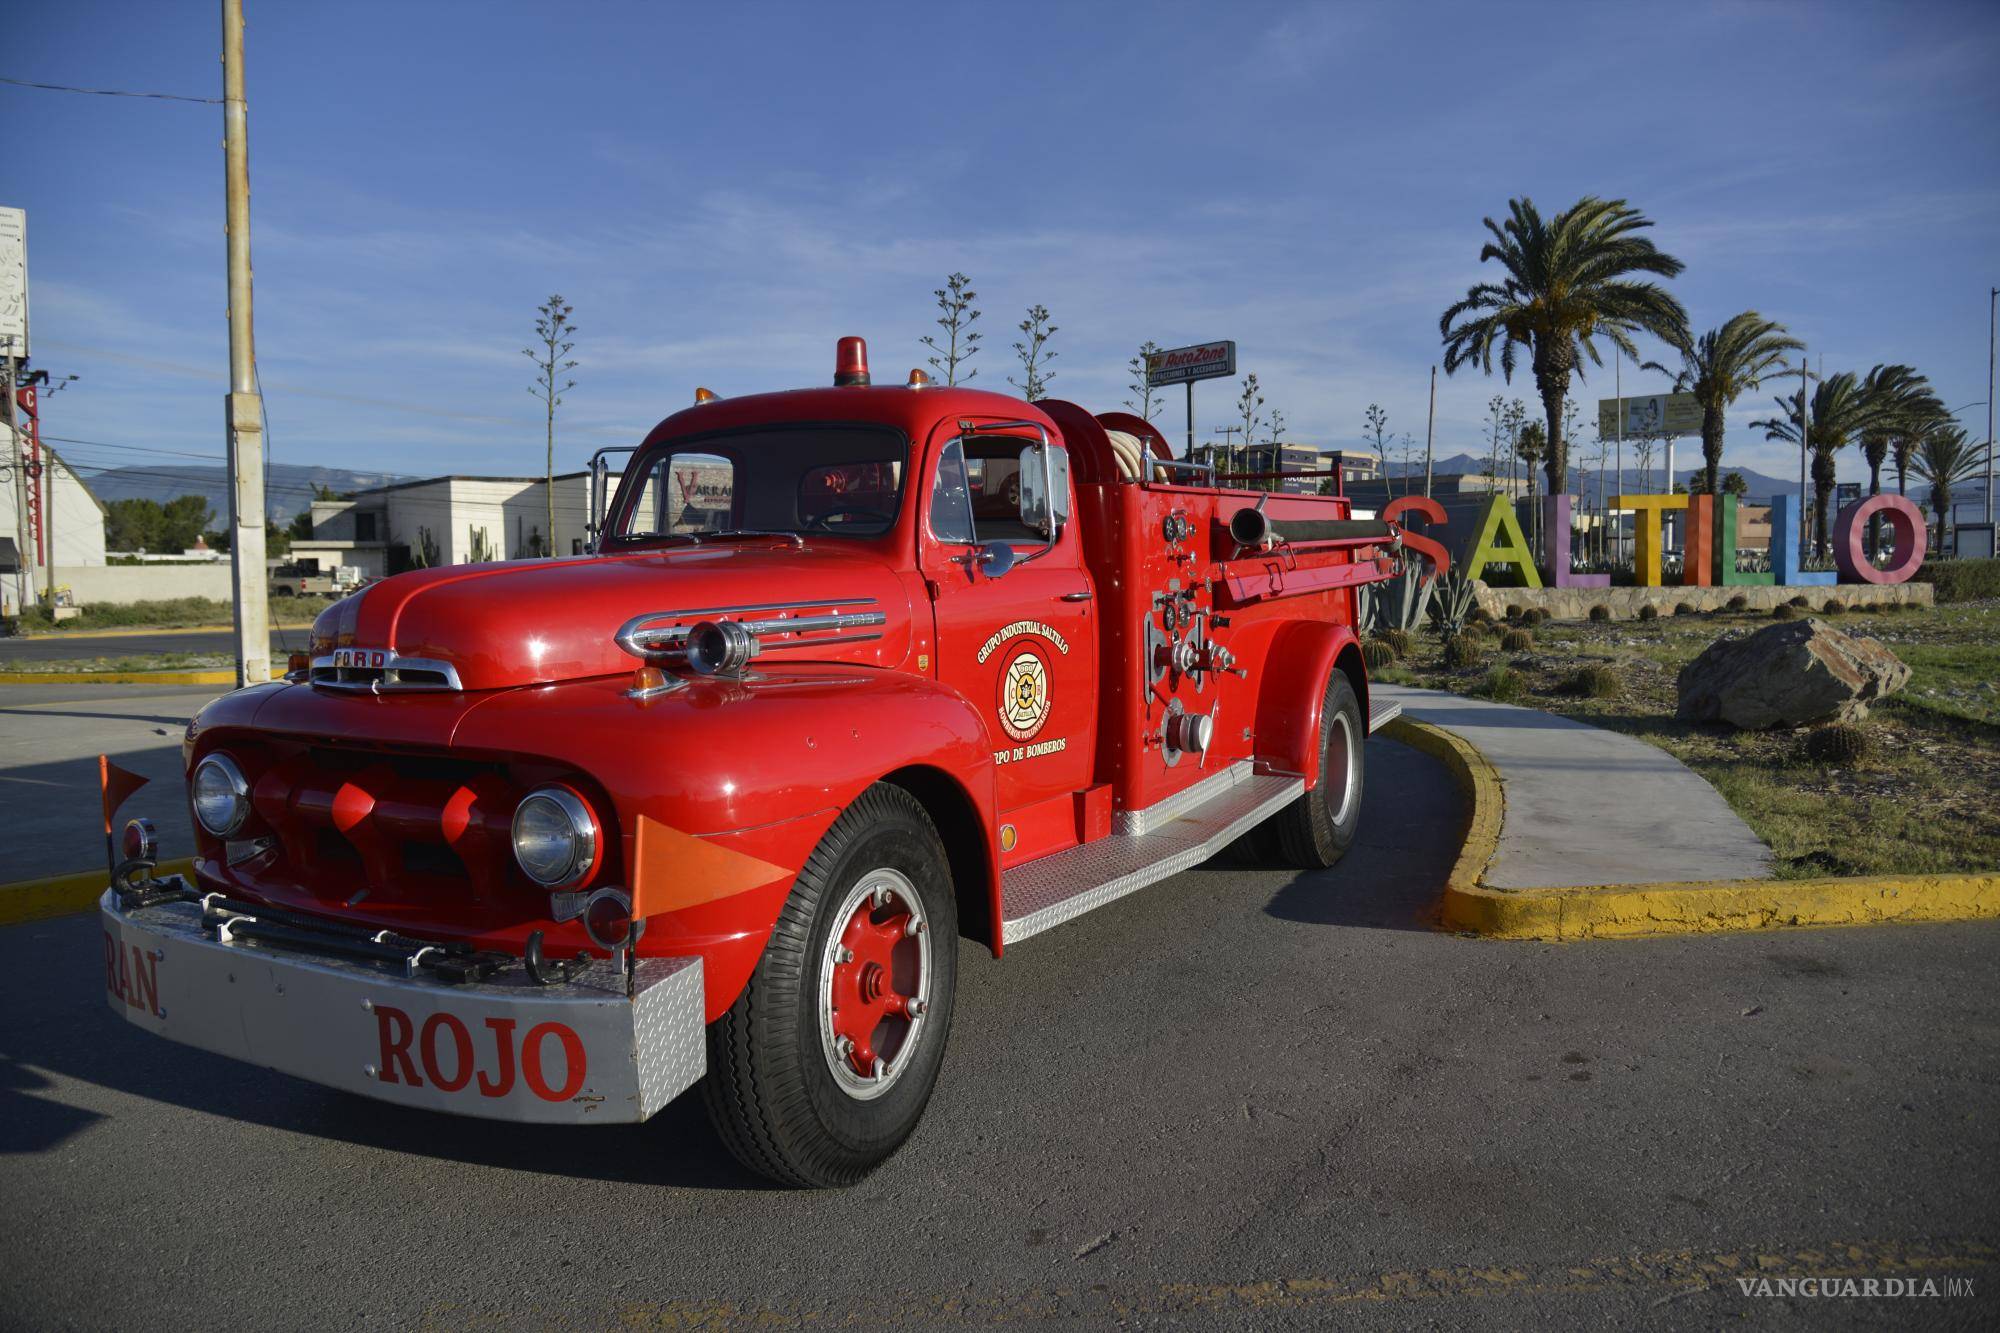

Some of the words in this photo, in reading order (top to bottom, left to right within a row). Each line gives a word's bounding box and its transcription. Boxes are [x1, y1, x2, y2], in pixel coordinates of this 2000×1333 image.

[1166, 347, 1226, 367] AutoZone
[1382, 494, 1928, 588] SALTILLO
[334, 651, 385, 667] FORD
[977, 632, 1001, 664] GRUPO
[1001, 621, 1041, 641] INDUSTRIAL
[1041, 624, 1069, 655] SALTILLO
[998, 705, 1021, 739] BOMBEROS
[1021, 700, 1051, 739] VOLUNTARIOS
[1013, 747, 1024, 761] DE
[1027, 738, 1066, 758] BOMBEROS
[374, 1005, 587, 1103] ROJO
